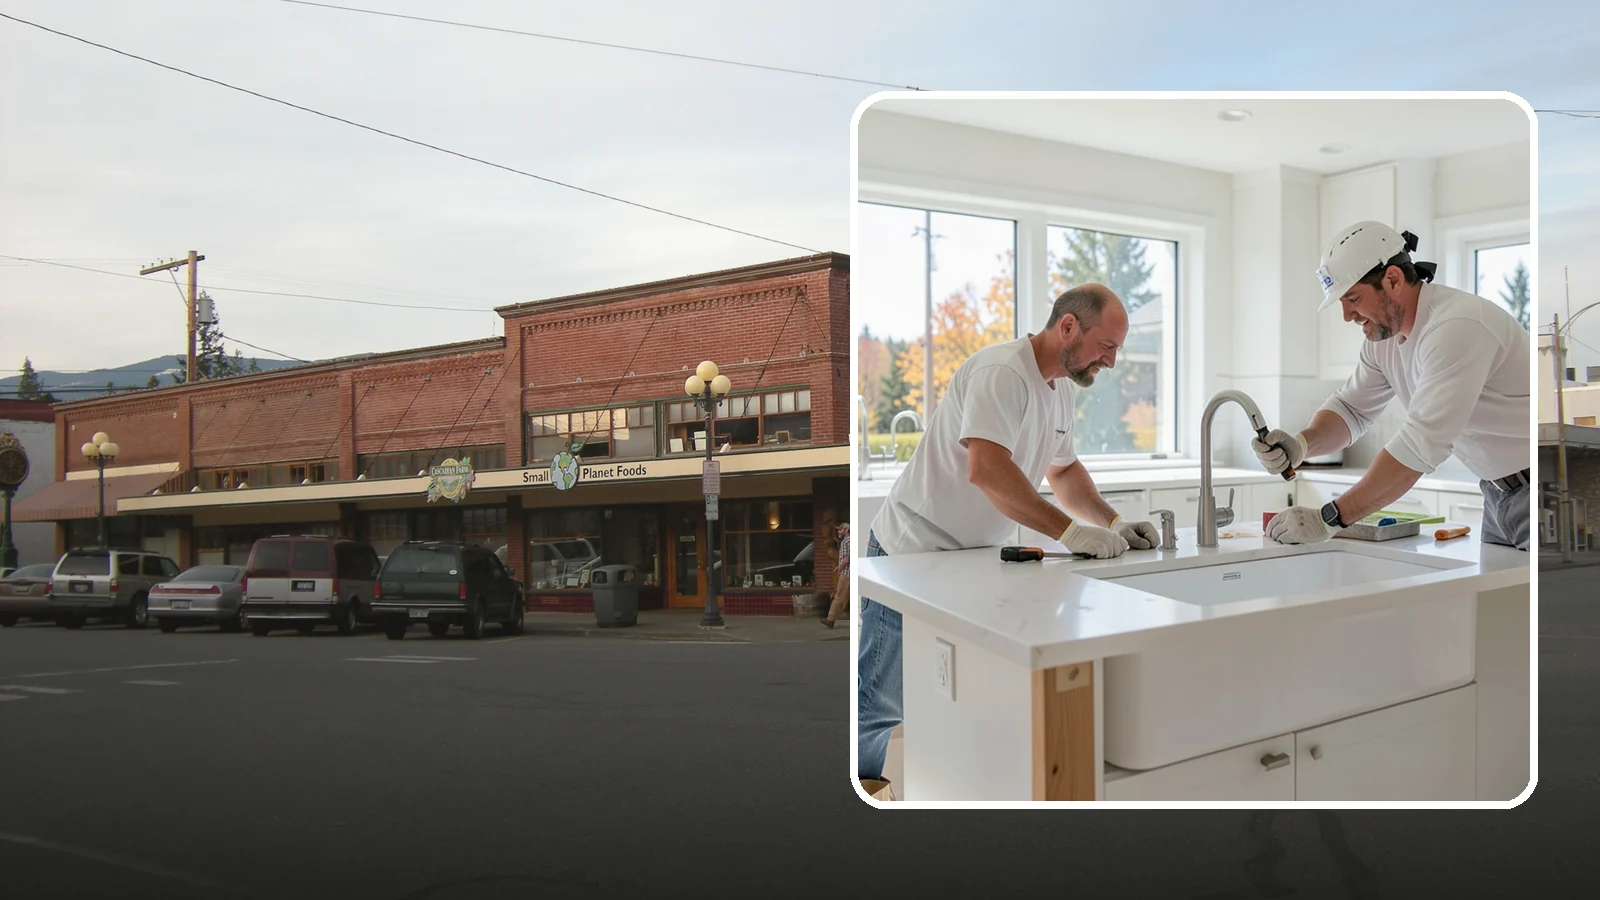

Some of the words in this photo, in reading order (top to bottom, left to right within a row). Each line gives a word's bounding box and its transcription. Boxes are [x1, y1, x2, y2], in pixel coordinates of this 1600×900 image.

[523, 471, 549, 483] Small
[582, 467, 614, 479] Planet
[616, 464, 647, 477] Foods
